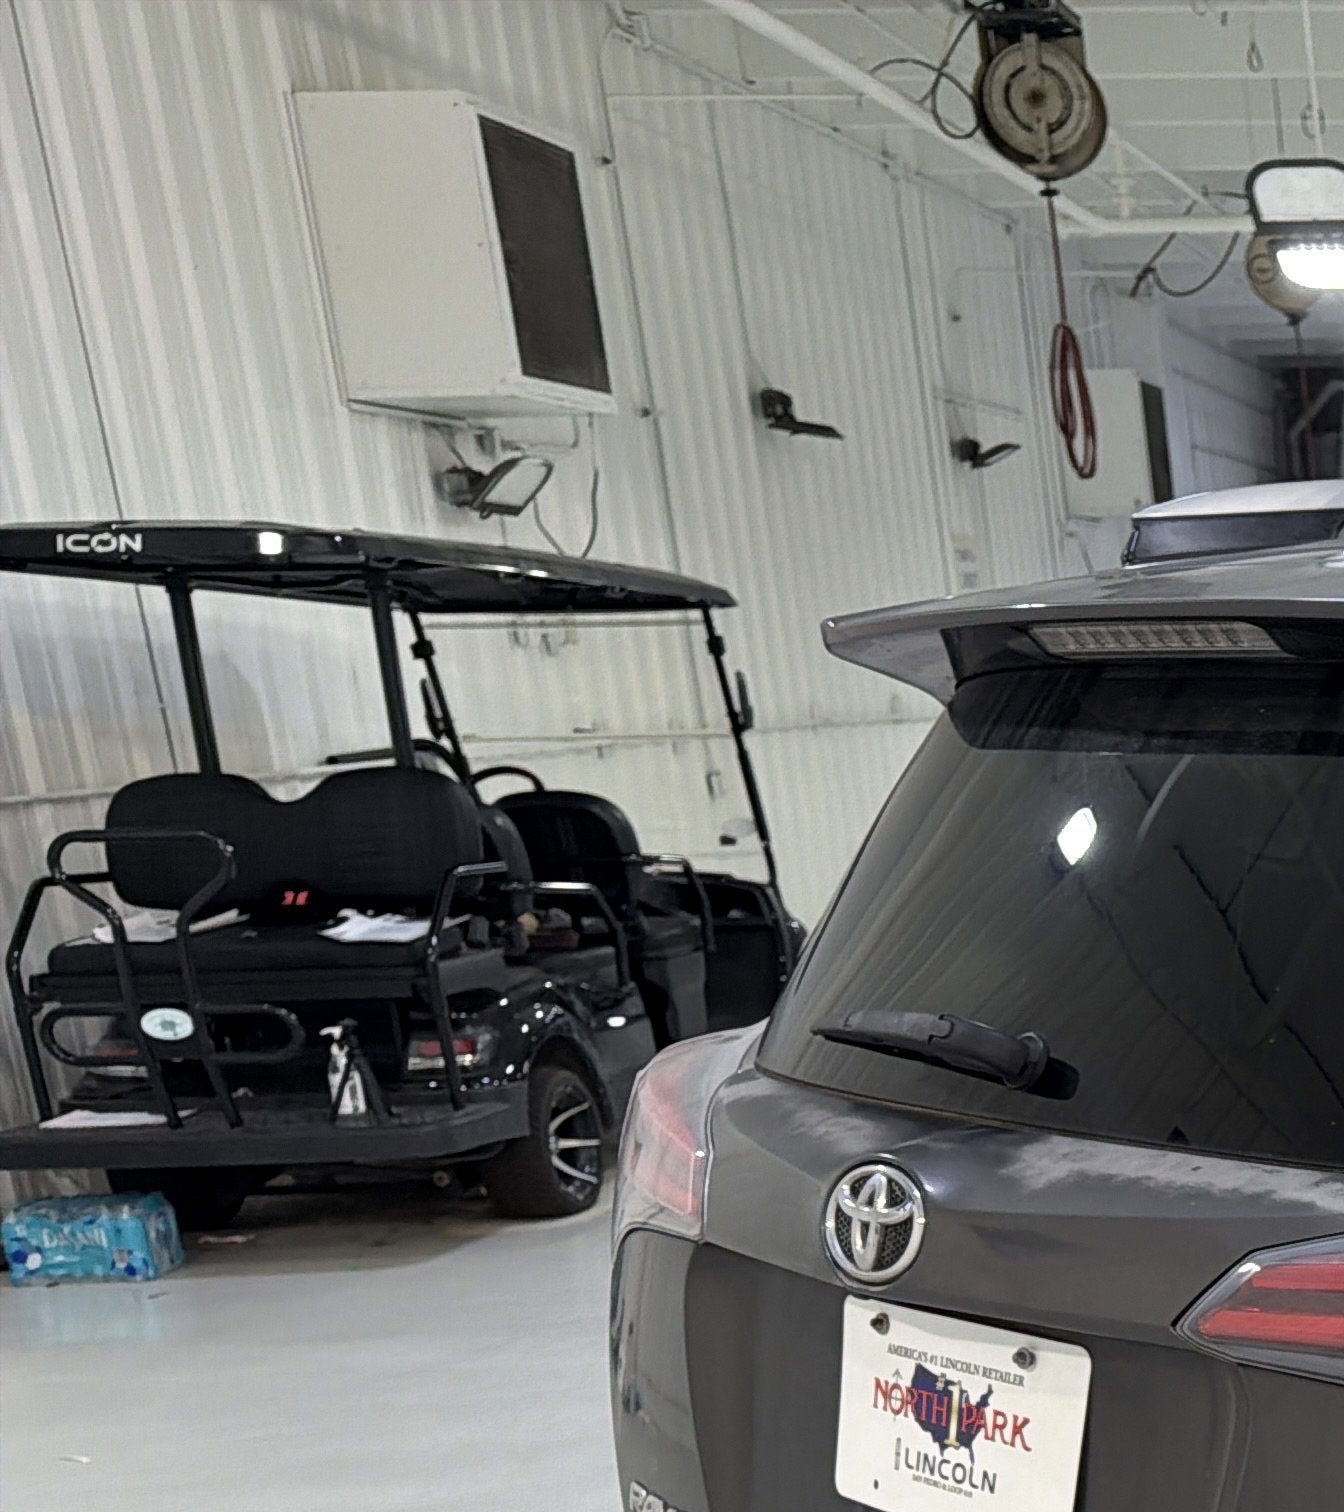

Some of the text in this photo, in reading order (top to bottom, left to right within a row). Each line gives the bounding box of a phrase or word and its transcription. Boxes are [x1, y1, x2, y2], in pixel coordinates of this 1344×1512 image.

[56, 532, 142, 553] ICON
[939, 1356, 982, 1377] LINCOLN
[981, 1366, 1026, 1388] RETAILER
[872, 1376, 1033, 1452] NORTH PARK
[904, 1447, 997, 1494] LINCOLN
